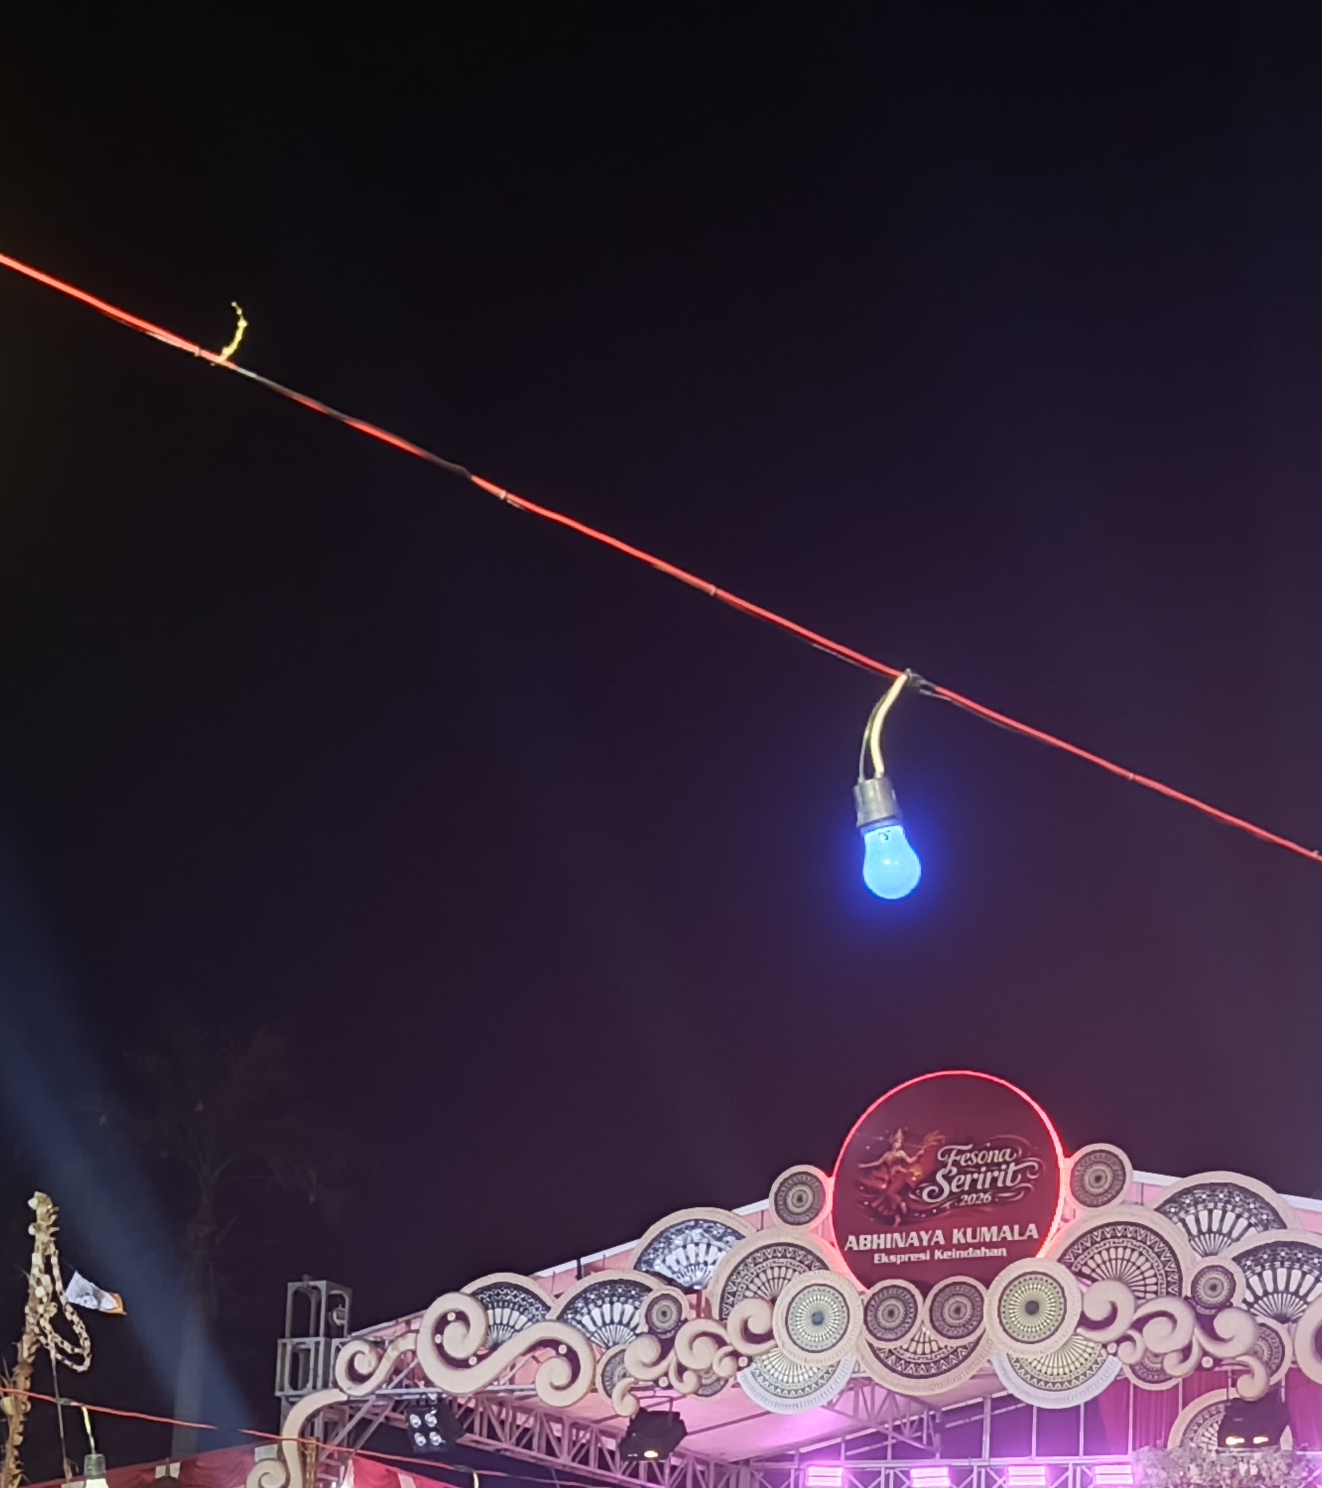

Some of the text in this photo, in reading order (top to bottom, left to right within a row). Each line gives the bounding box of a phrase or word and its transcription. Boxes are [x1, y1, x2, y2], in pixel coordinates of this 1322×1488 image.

[937, 1143, 1017, 1174] Fesona
[922, 1162, 1039, 1203] Seririt
[958, 1192, 992, 1206] 2026
[844, 1223, 1039, 1251] ABHINAYA KUMALA
[873, 1246, 1007, 1265] Ekspresi Keindahan
